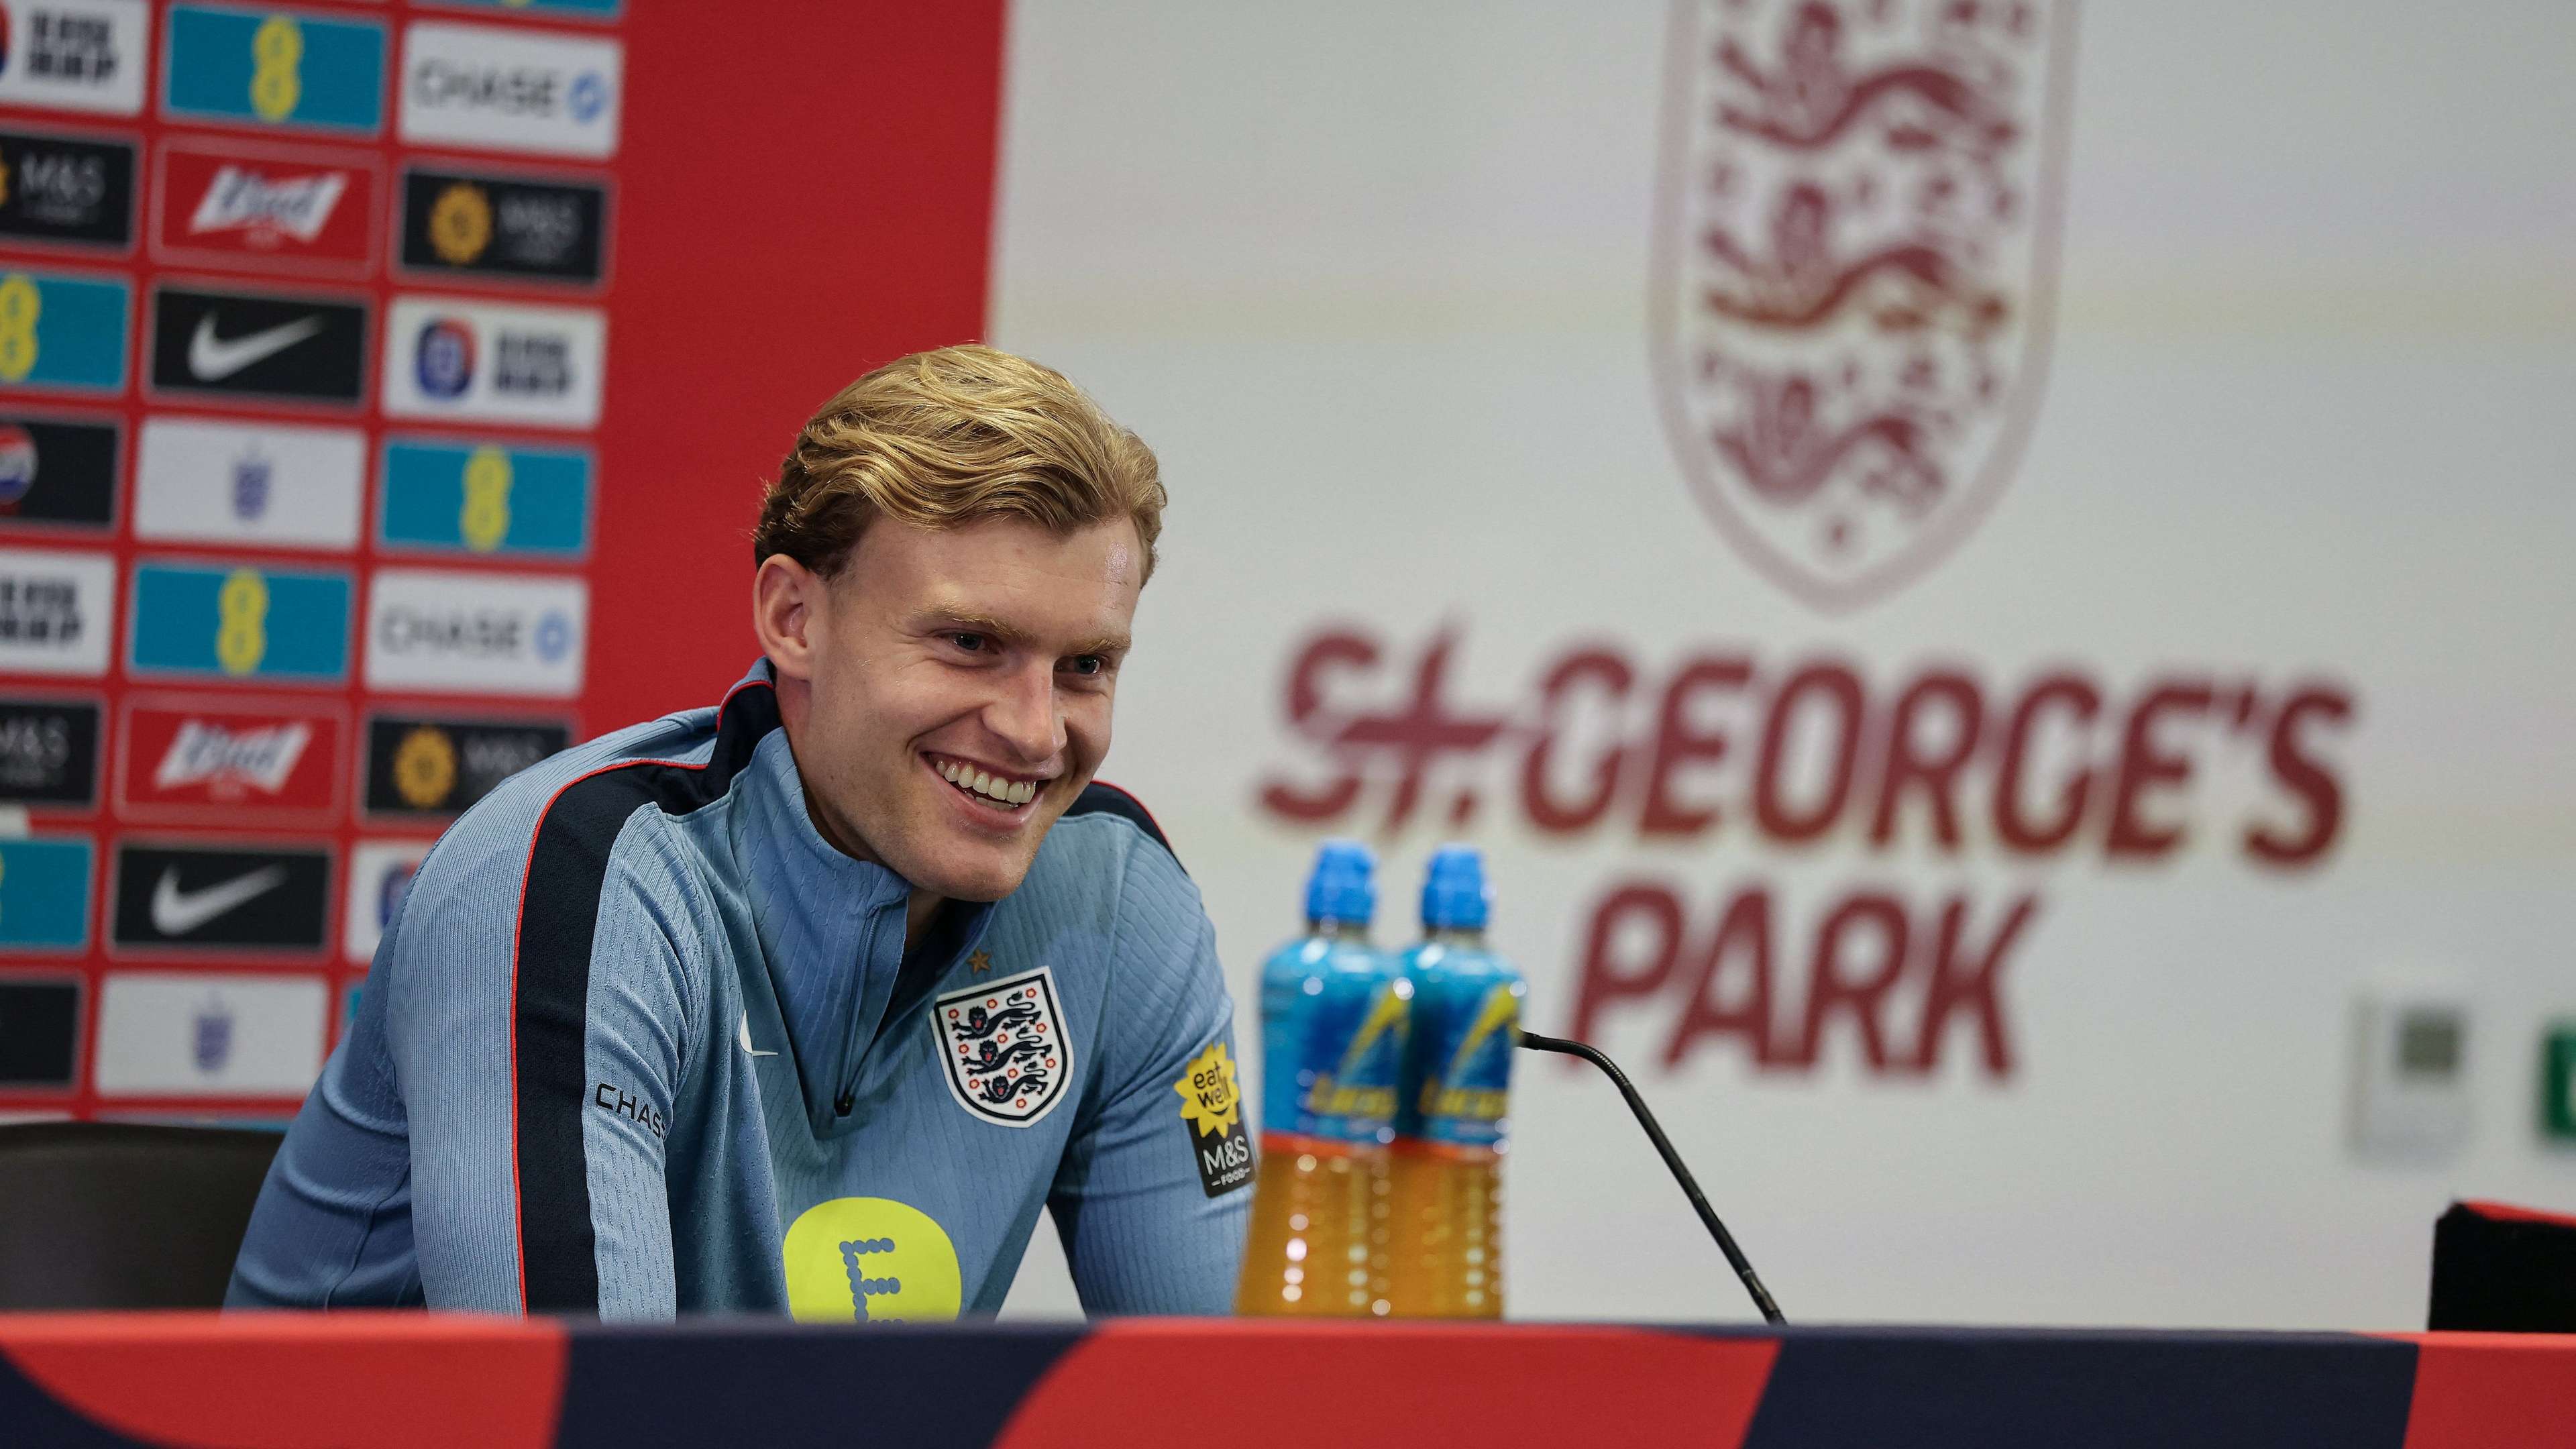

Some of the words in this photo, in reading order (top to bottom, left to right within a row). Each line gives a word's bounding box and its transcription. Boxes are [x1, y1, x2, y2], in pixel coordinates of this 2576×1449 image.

[1521, 647, 2353, 865] GEORGE'S
[1568, 884, 2035, 1077] PARK
[1194, 1062, 1220, 1089] eat
[1197, 1077, 1230, 1109] well
[596, 1083, 666, 1140] CHAS
[1203, 1135, 1249, 1175] M&S
